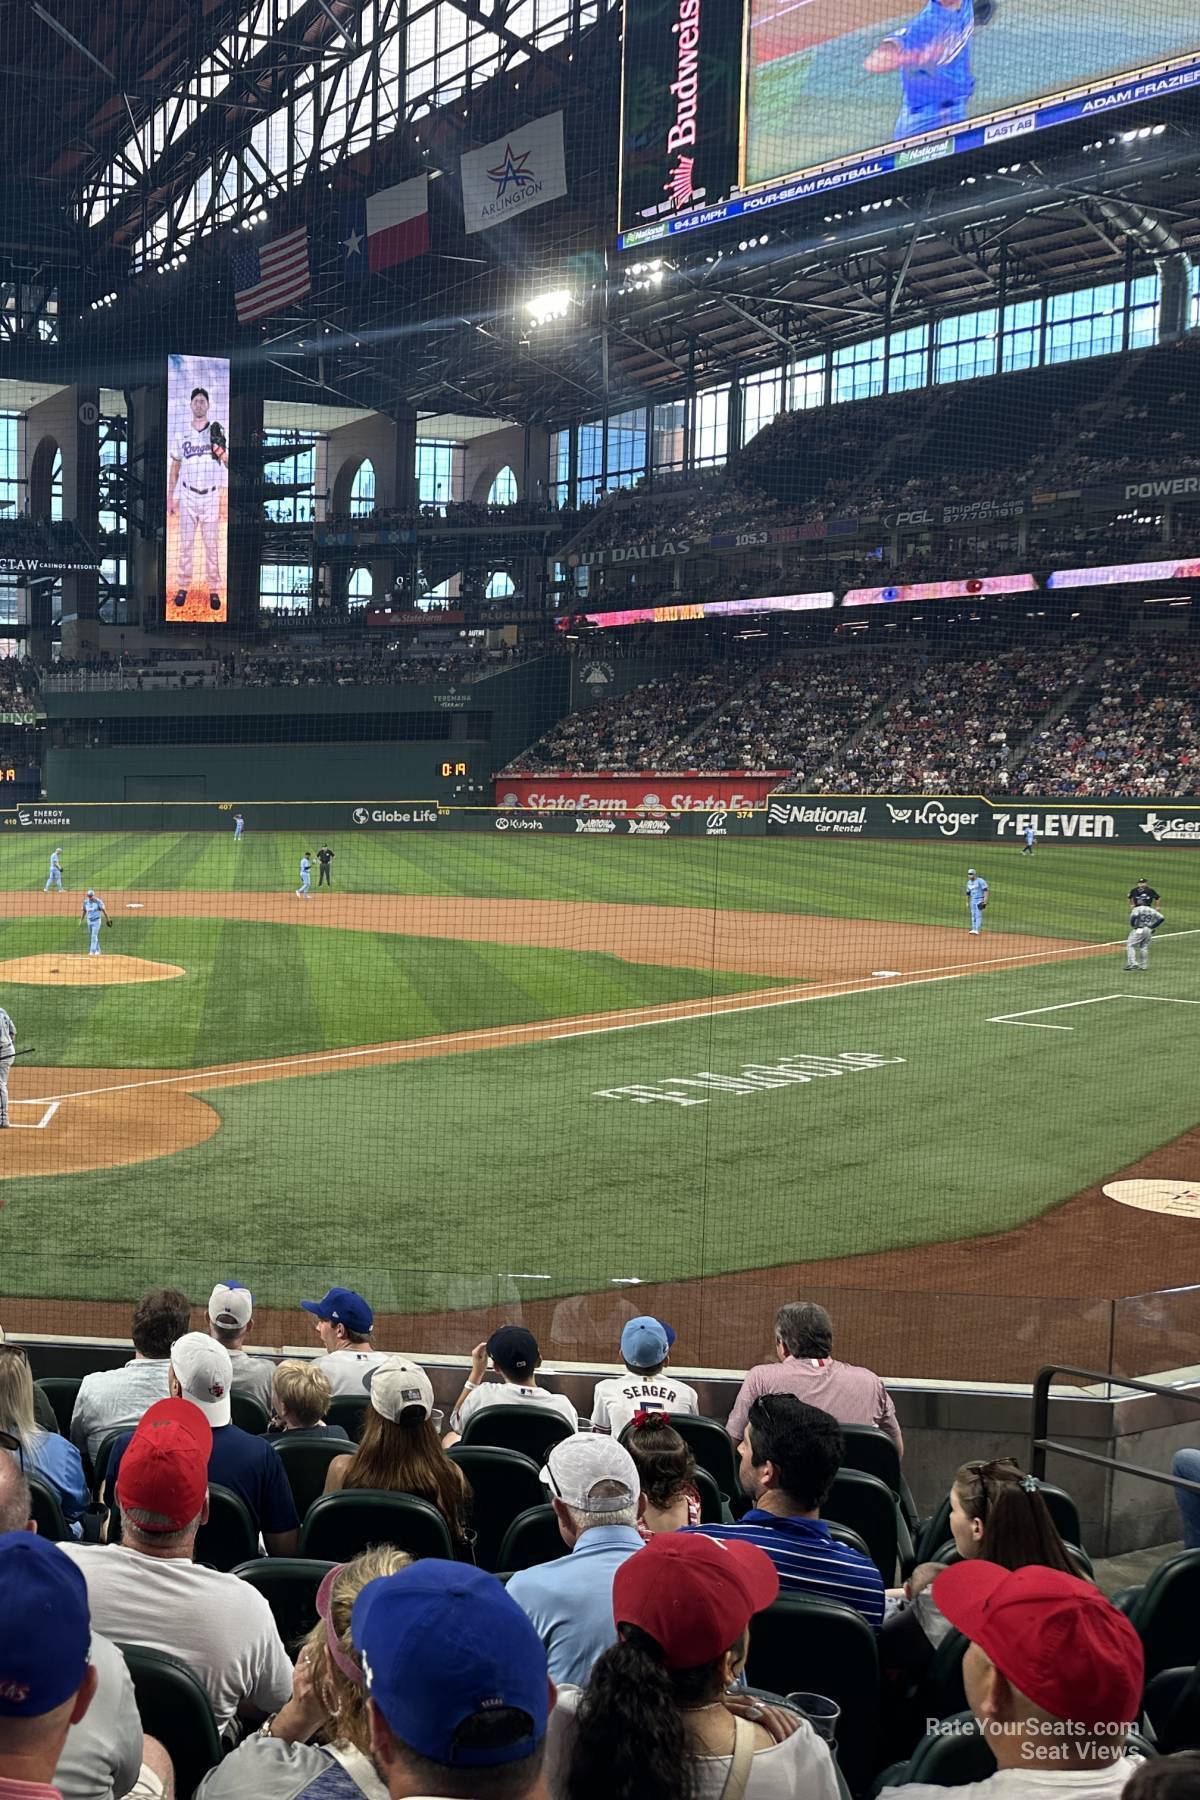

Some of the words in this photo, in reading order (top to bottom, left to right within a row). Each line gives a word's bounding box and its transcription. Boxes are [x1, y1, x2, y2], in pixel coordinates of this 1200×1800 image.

[1082, 90, 1132, 113] ADAM
[987, 125, 1015, 140] LAST
[1017, 120, 1032, 132] AB
[909, 140, 948, 160] National
[743, 182, 816, 210] FOUR-SEAM
[816, 164, 883, 193] FASTBALL
[481, 180, 543, 218] ARLINGTON
[674, 215, 699, 230] 94.2
[700, 208, 727, 223] MPH
[81, 407, 95, 420] 10
[896, 510, 934, 526] PGL
[735, 531, 768, 546] 105.3
[580, 551, 607, 566] UT
[611, 540, 691, 562] DALLAS
[442, 763, 466, 777] 0:19
[372, 810, 410, 822] Globe
[414, 810, 438, 822] Life
[510, 819, 543, 830] Kubota
[815, 824, 830, 832] Car
[833, 824, 862, 832] Rental
[623, 1385, 677, 1403] SEAGER
